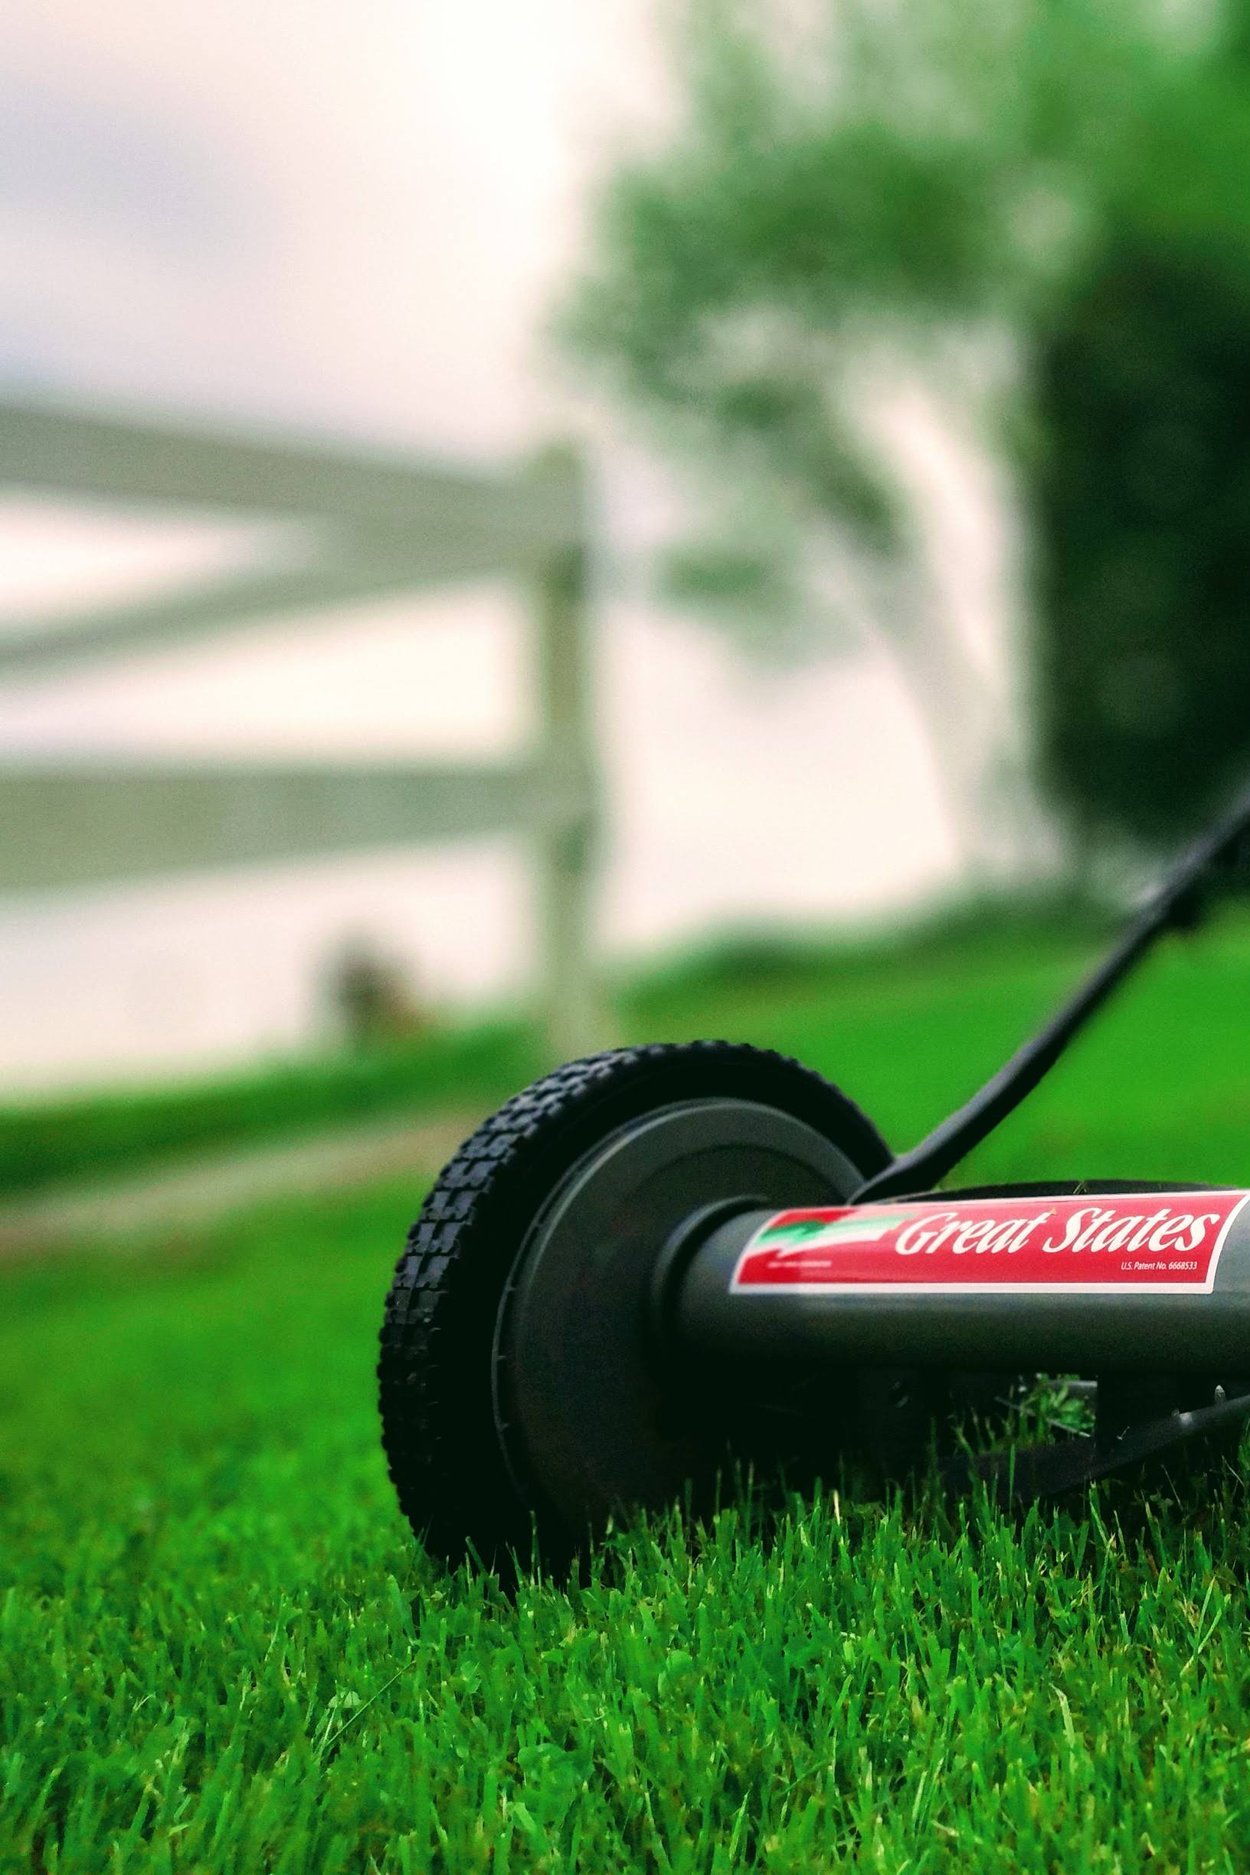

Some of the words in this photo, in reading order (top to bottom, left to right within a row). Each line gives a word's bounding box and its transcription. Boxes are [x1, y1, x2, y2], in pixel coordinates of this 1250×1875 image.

[895, 1211, 1049, 1255] Great
[1042, 1207, 1220, 1253] States
[1120, 1261, 1132, 1270] U.S.
[1133, 1261, 1155, 1270] Patent
[1155, 1261, 1167, 1270] No.
